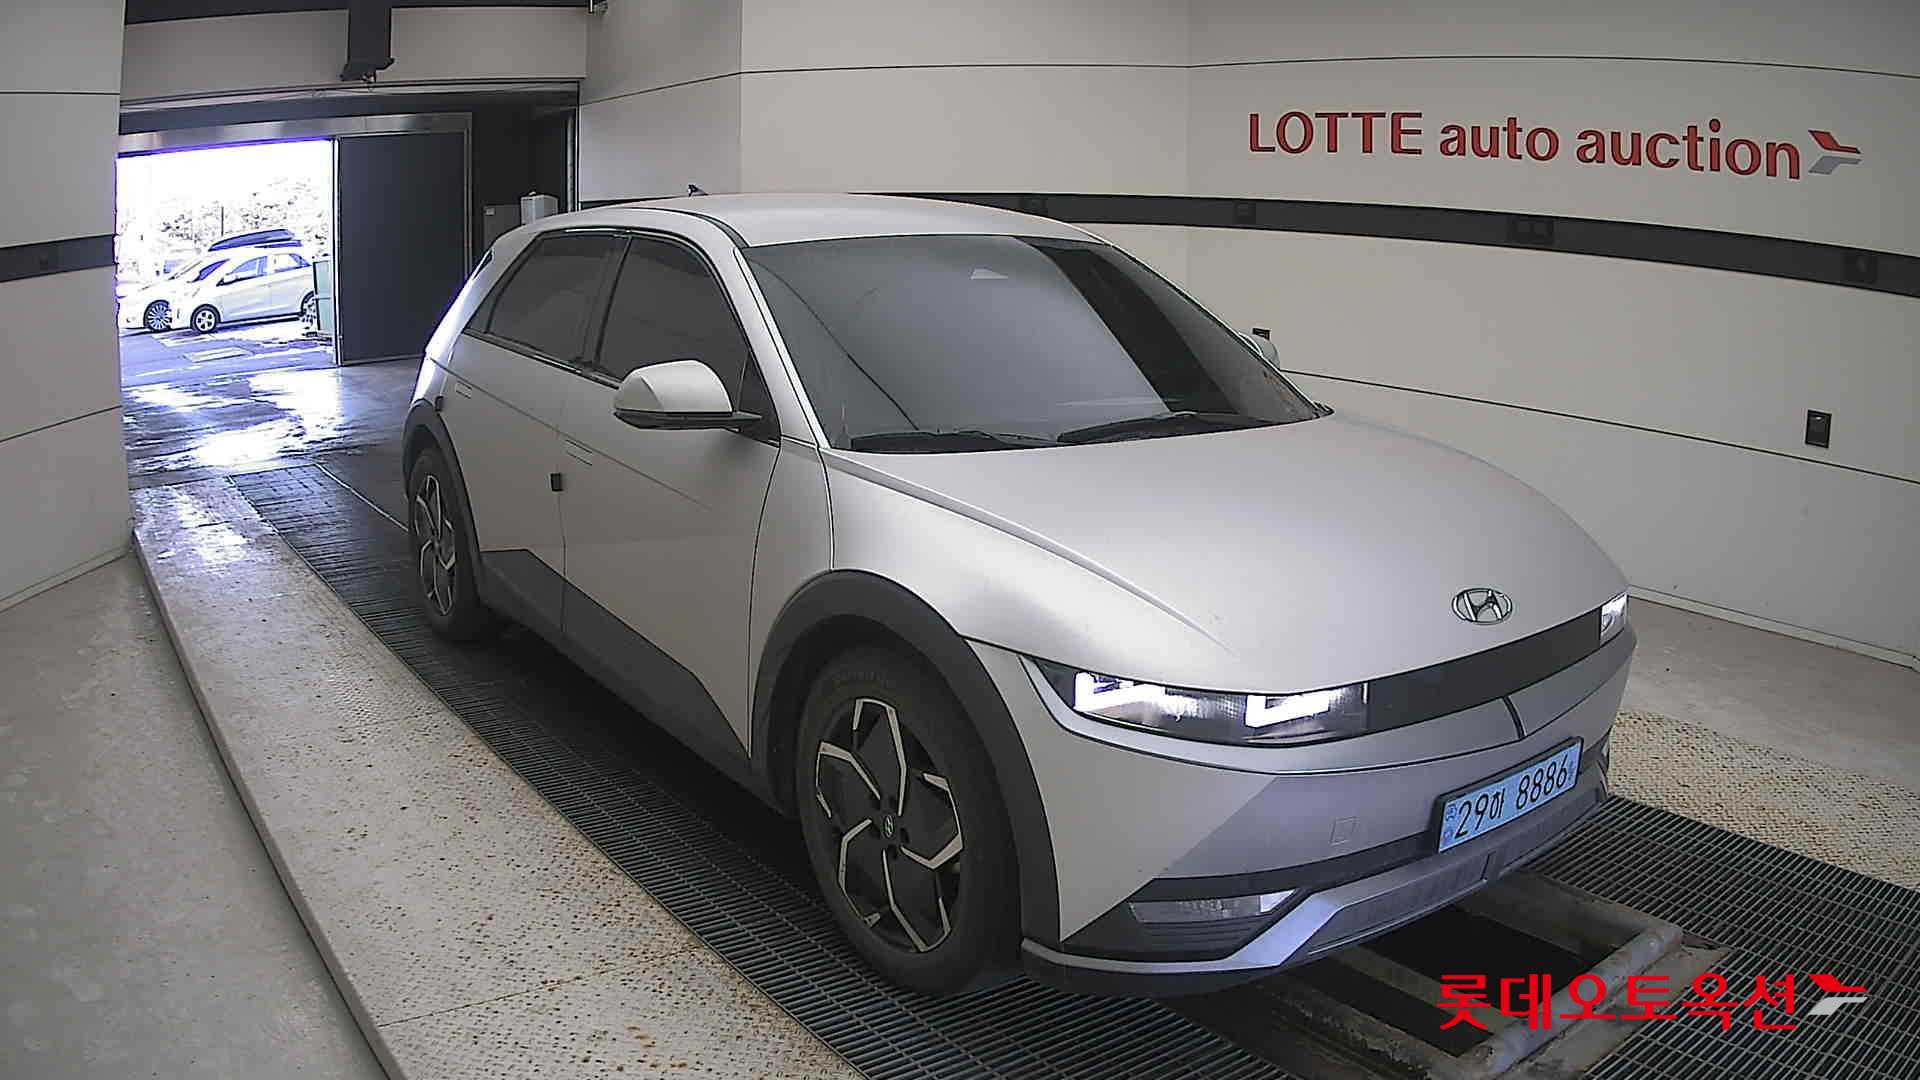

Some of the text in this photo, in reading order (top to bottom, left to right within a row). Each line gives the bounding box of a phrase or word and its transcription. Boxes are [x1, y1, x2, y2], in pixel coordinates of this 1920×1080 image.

[1248, 111, 1801, 180] LOTTE auto auction
[1454, 753, 1569, 840] 29하 8886
